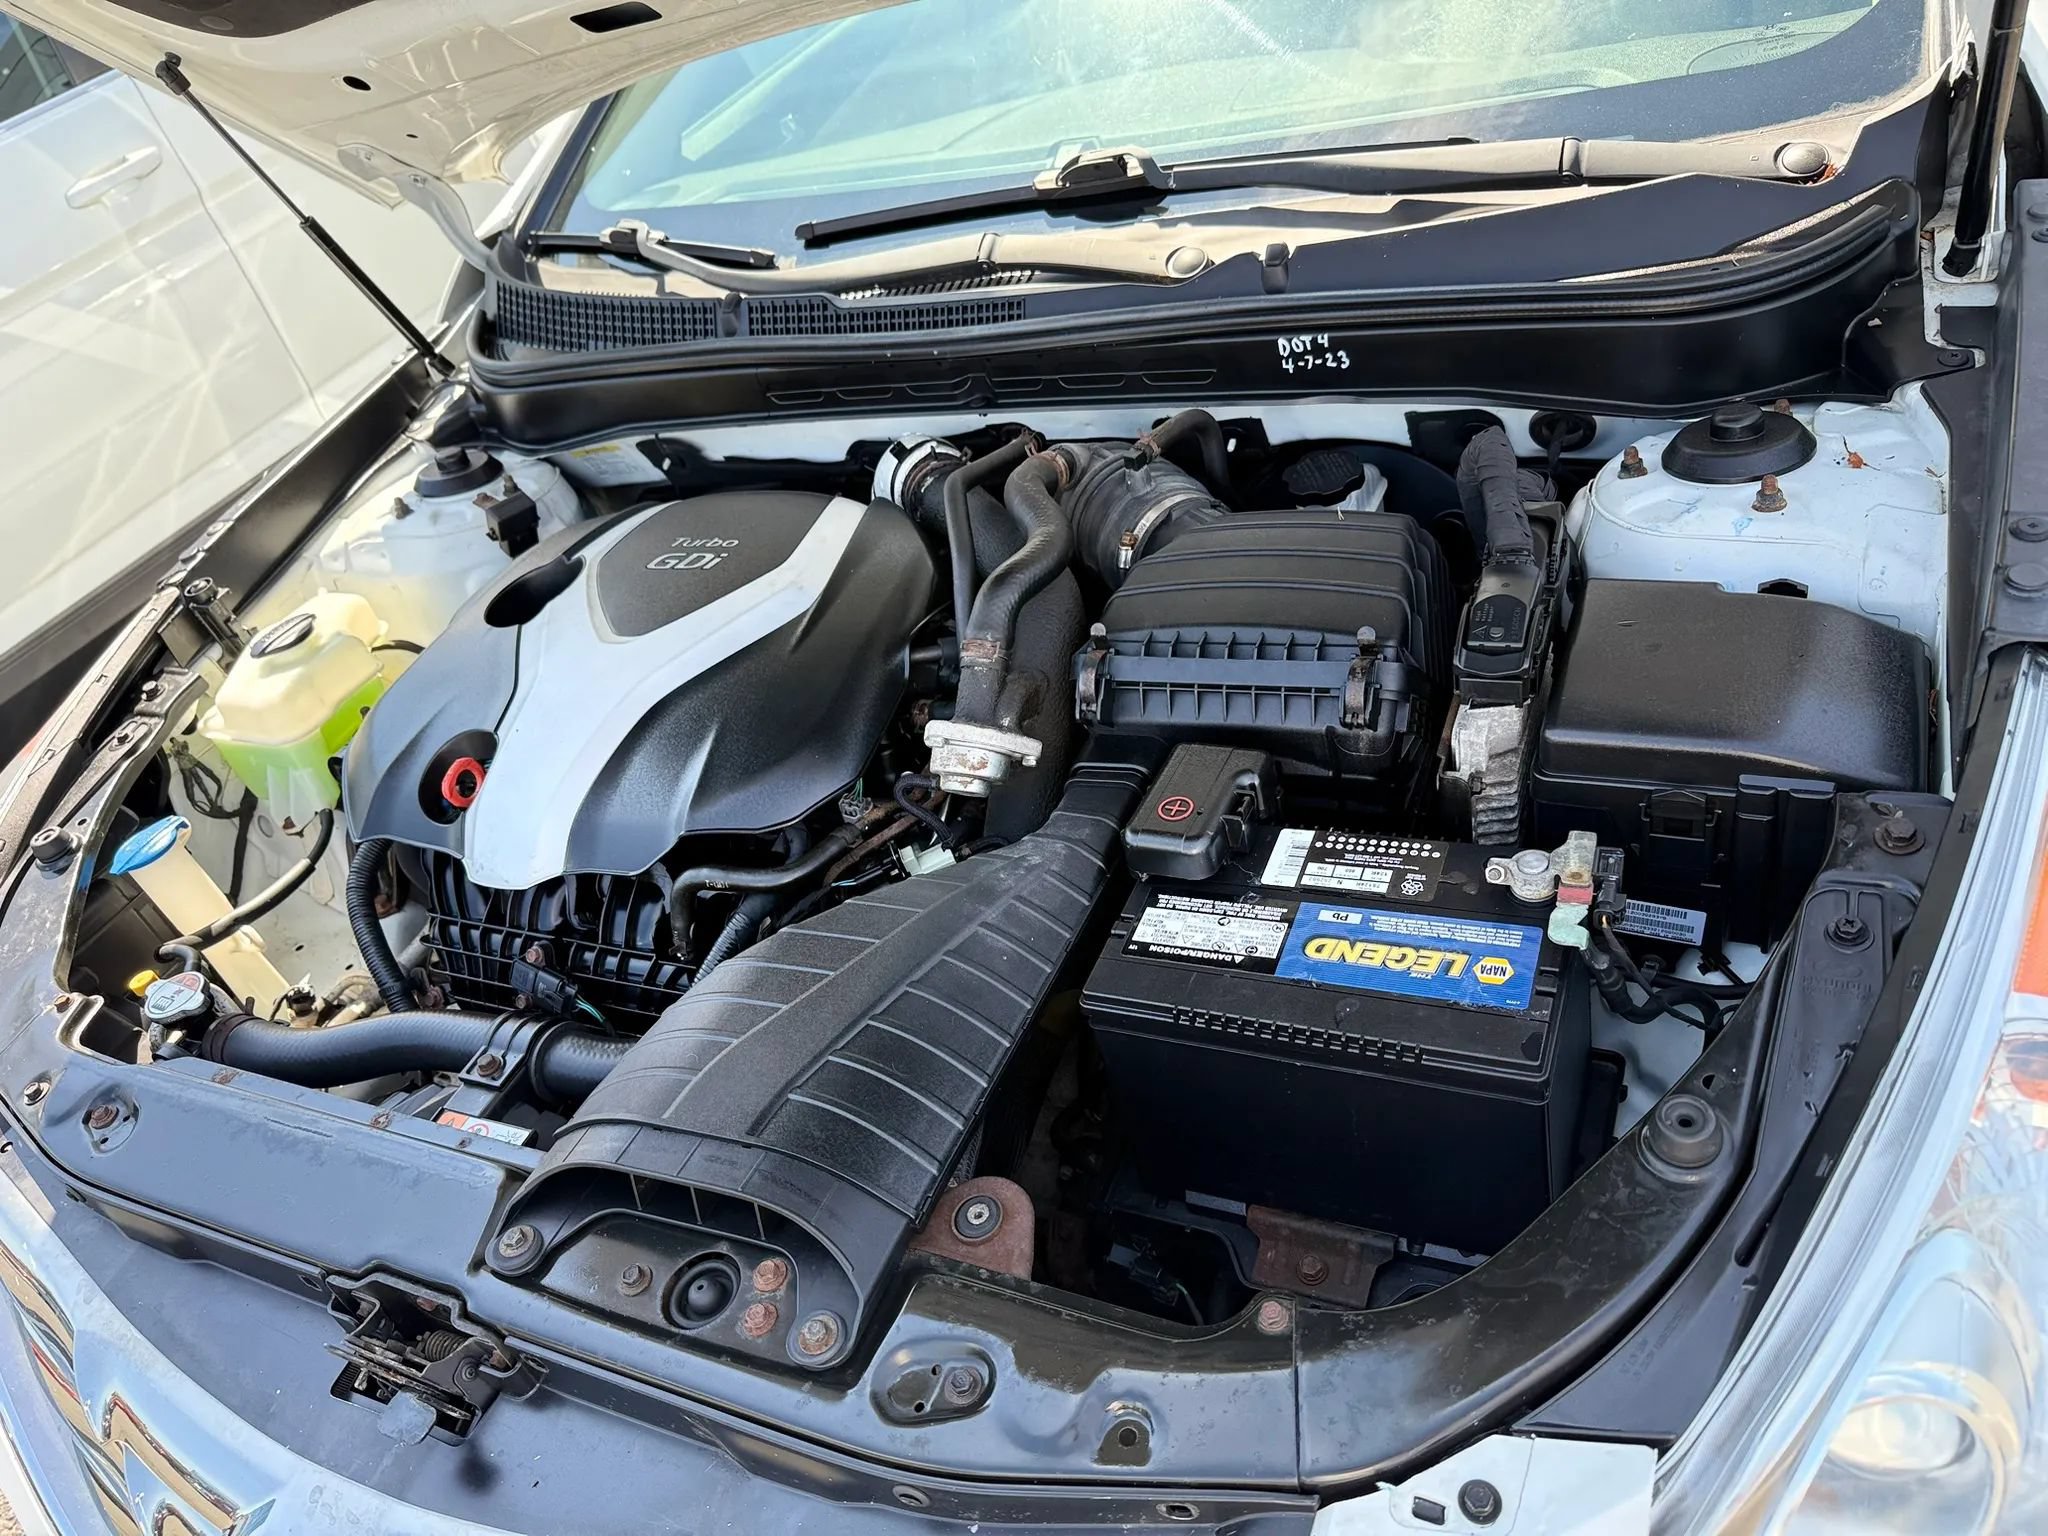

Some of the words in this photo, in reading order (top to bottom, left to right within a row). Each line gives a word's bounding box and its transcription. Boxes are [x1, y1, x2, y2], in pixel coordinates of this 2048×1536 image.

[1277, 335, 1314, 358] DOT
[1317, 332, 1330, 349] 4
[1281, 350, 1352, 375] 4-7-23
[671, 536, 740, 549] Turbo
[645, 552, 728, 571] GDi
[1331, 911, 1349, 921] Pb
[1149, 945, 1233, 962] DANGER/POISON
[1303, 937, 1472, 978] LEGEND
[1407, 971, 1432, 980] THE
[1478, 962, 1507, 977] NAPA
